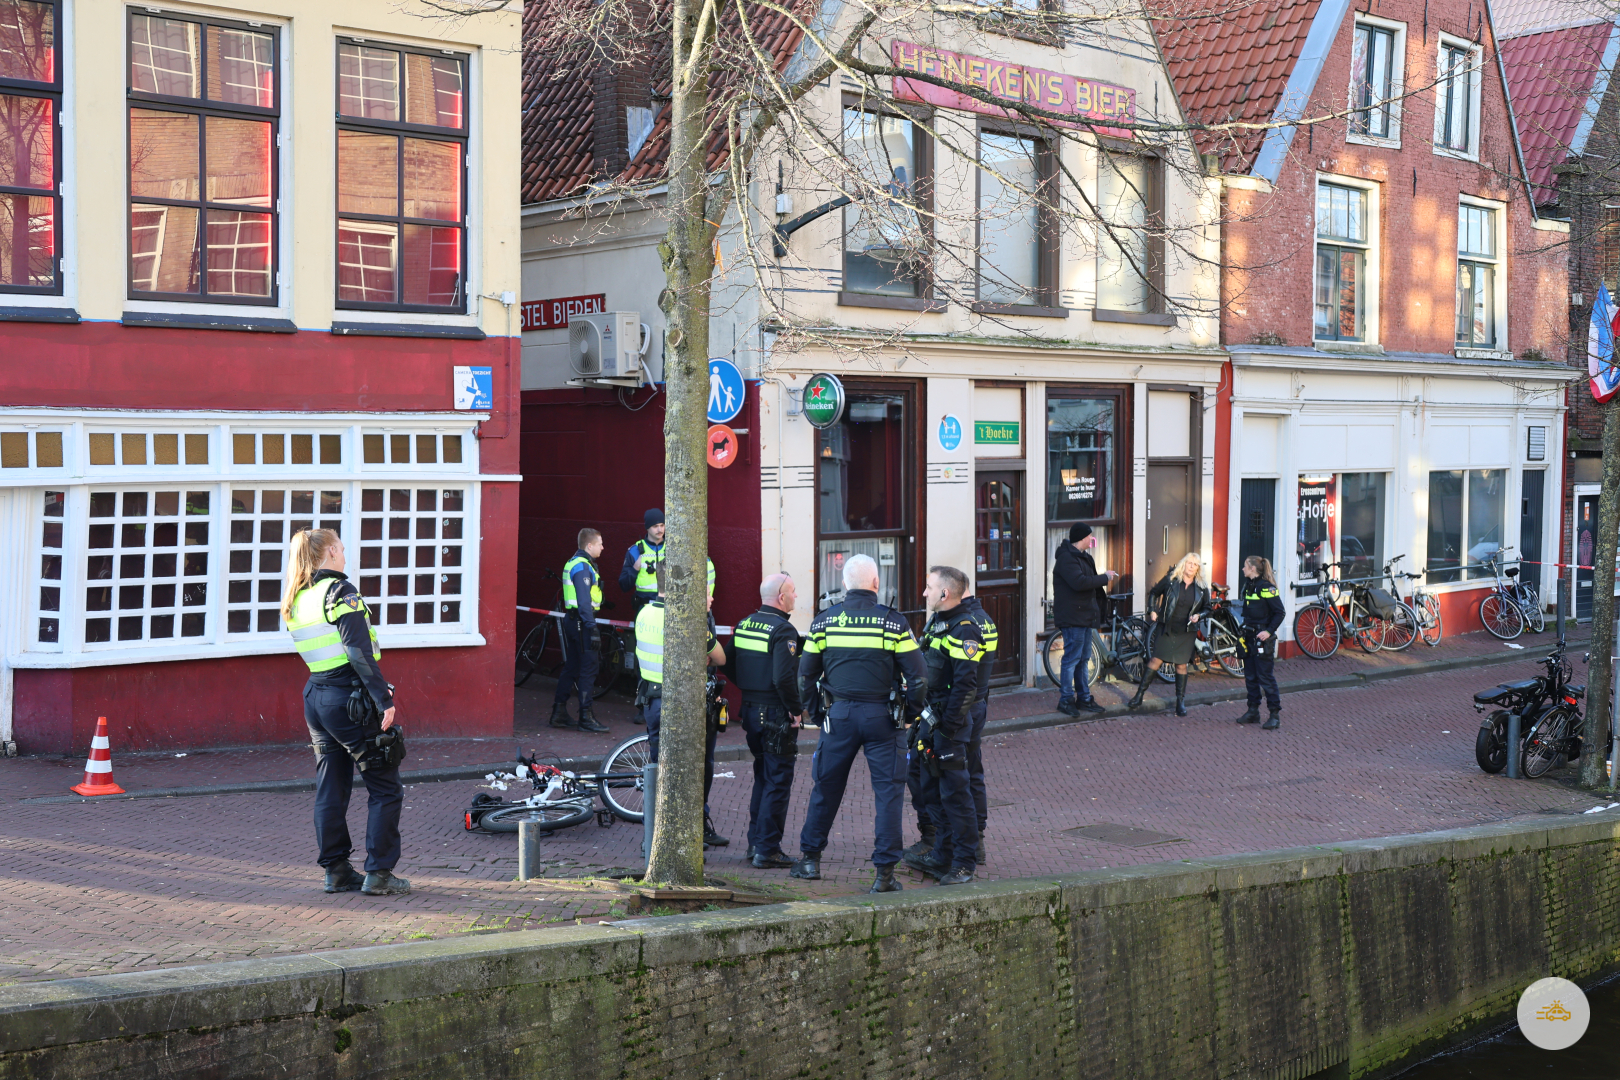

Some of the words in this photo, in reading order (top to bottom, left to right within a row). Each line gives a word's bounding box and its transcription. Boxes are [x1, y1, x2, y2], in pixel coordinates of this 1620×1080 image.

[899, 45, 1064, 111] HEINEKEN'S
[1076, 81, 1131, 119] BIER
[805, 402, 834, 410] Heineken
[1300, 487, 1325, 496] Eroscentrum
[1303, 498, 1335, 523] Hofje
[832, 613, 878, 626] POLITIE
